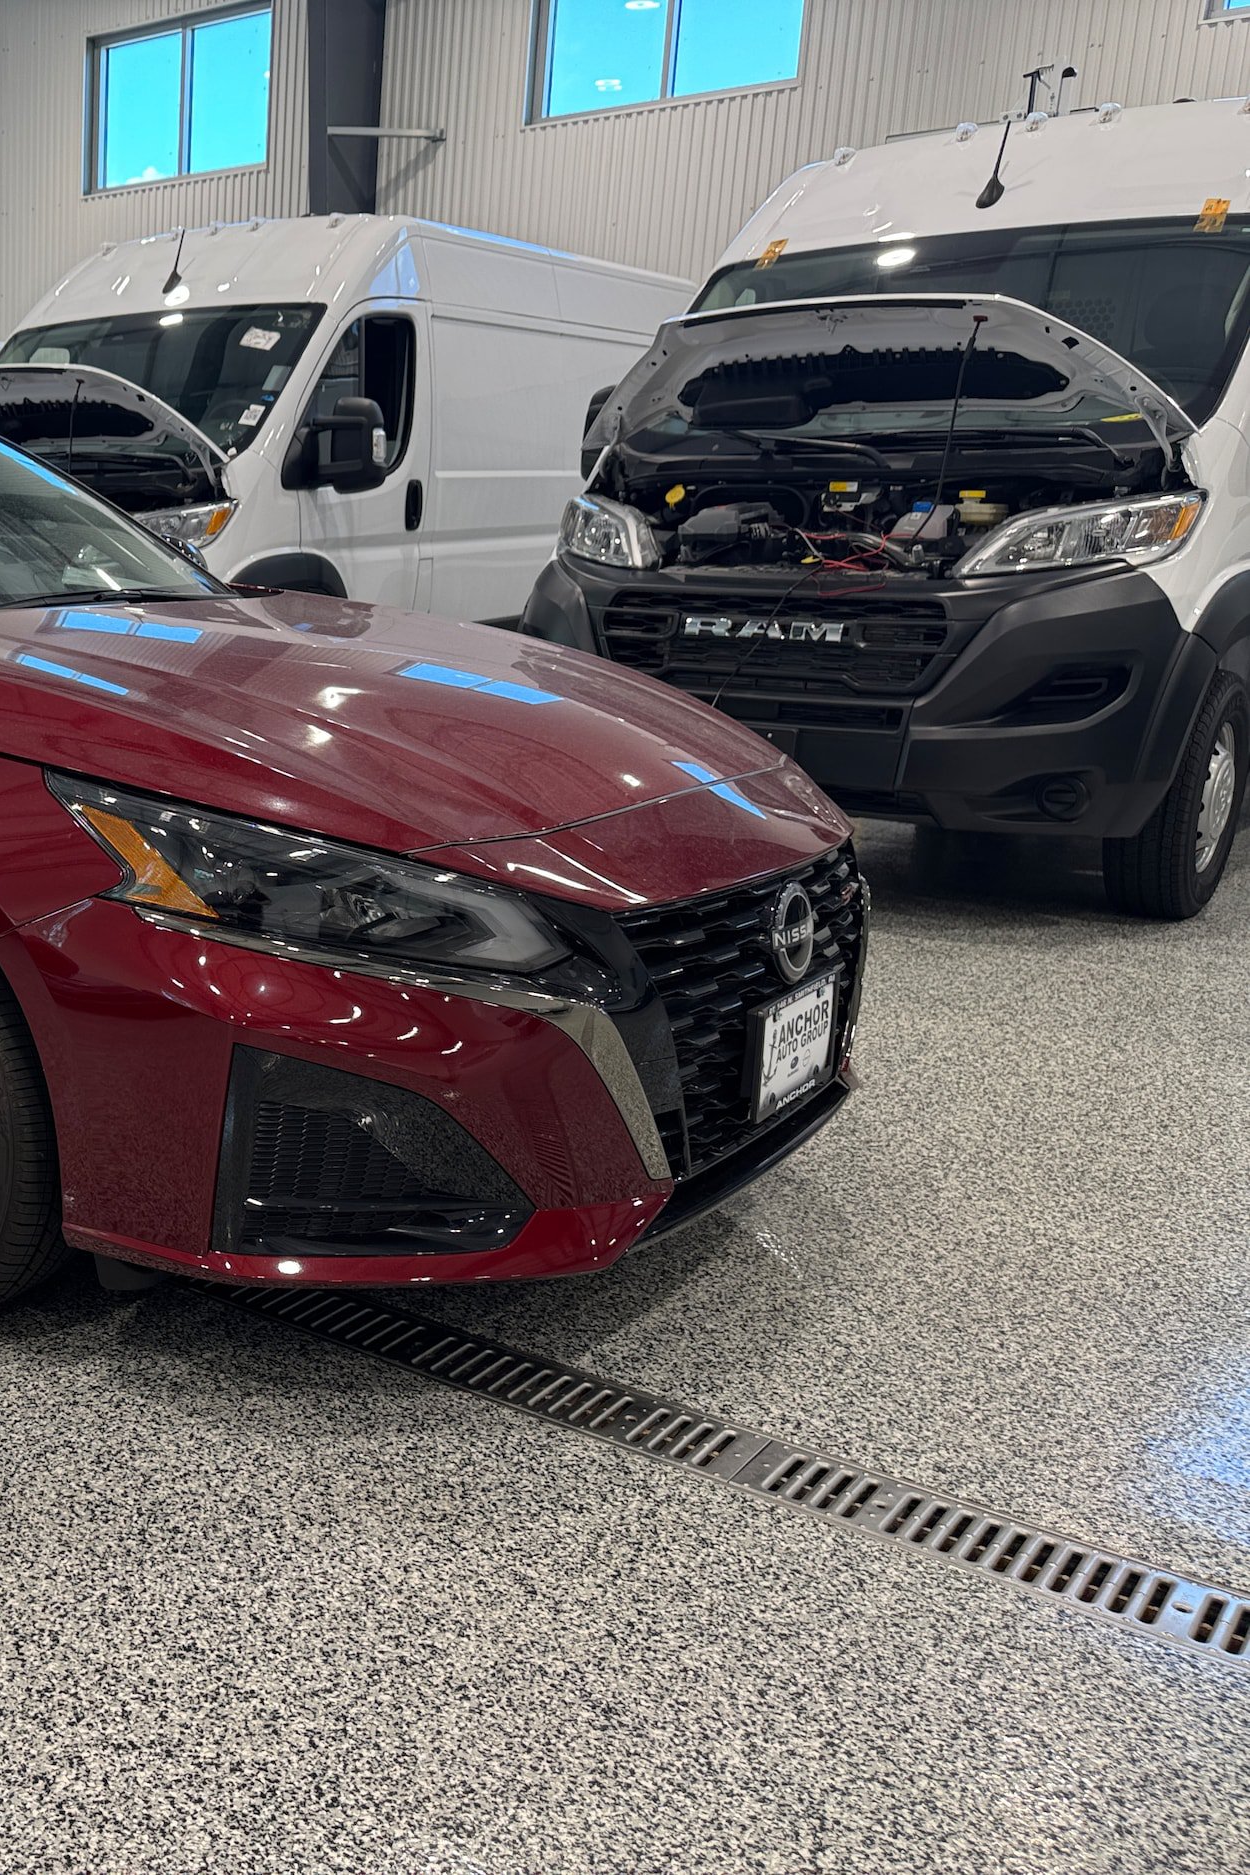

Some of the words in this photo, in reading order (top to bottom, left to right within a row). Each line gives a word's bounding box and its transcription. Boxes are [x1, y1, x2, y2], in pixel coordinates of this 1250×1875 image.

[684, 617, 845, 643] RAM
[774, 921, 814, 947] NISSA
[778, 1000, 829, 1047] ANCHOR
[776, 1038, 798, 1064] AUTO
[801, 1020, 829, 1047] GROUP
[775, 1078, 816, 1110] ANCHOR
